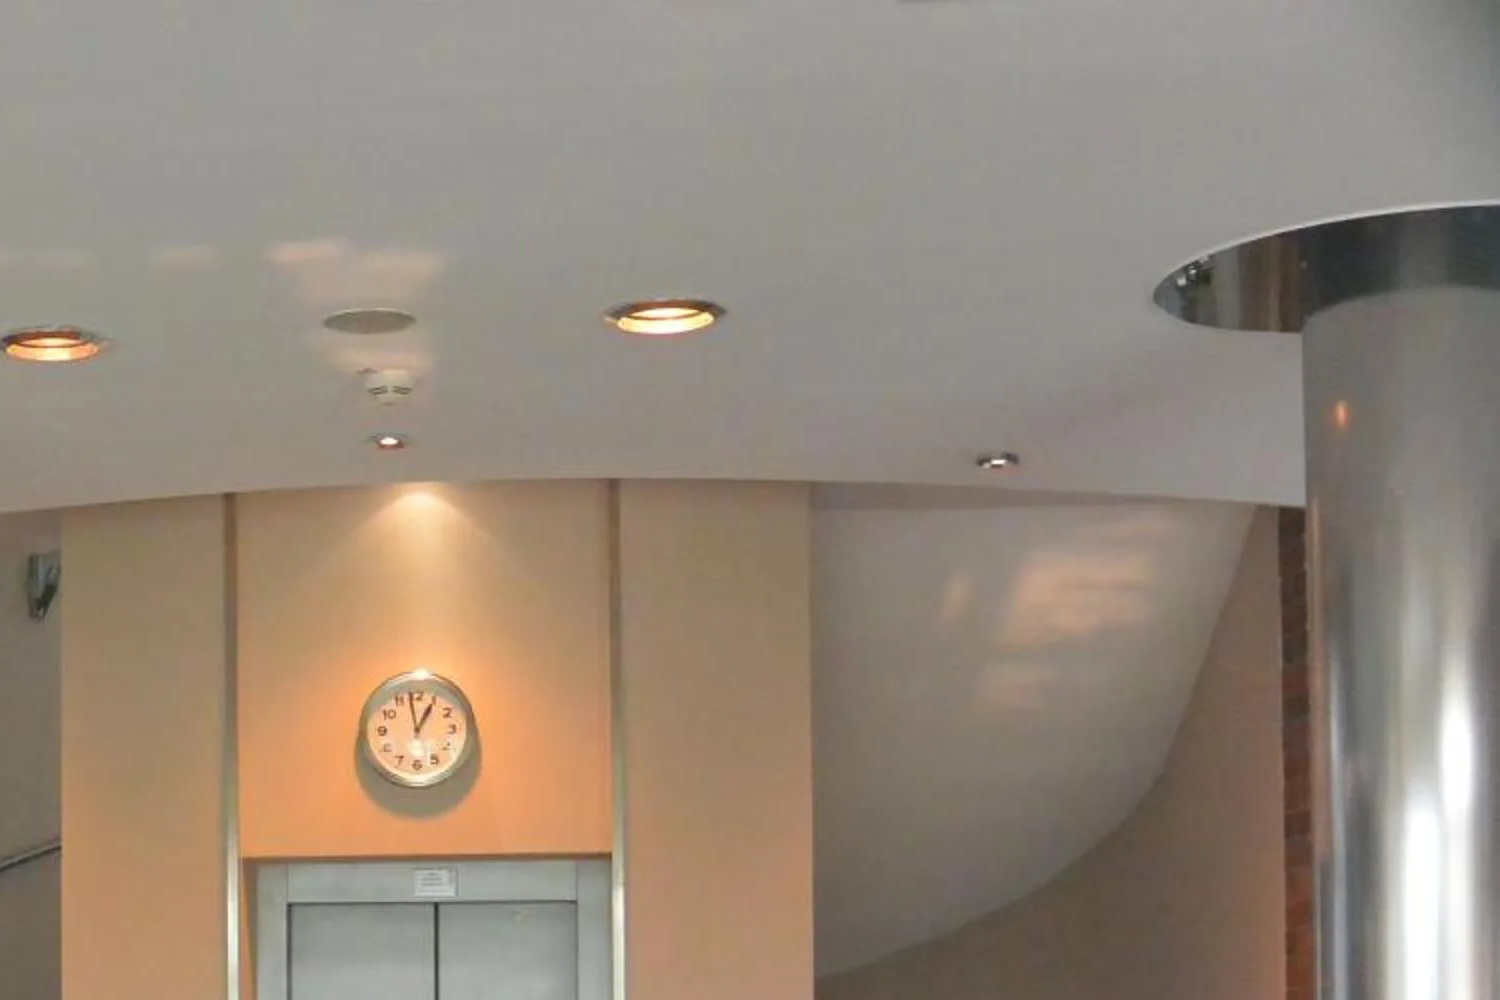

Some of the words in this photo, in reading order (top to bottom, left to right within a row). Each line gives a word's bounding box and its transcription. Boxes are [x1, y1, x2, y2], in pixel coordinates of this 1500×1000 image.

[382, 709, 397, 720] 10
[442, 707, 452, 719] 2
[377, 725, 388, 737] 9
[395, 755, 405, 767] 7
[412, 759, 423, 771] 6
[430, 754, 439, 765] 5
